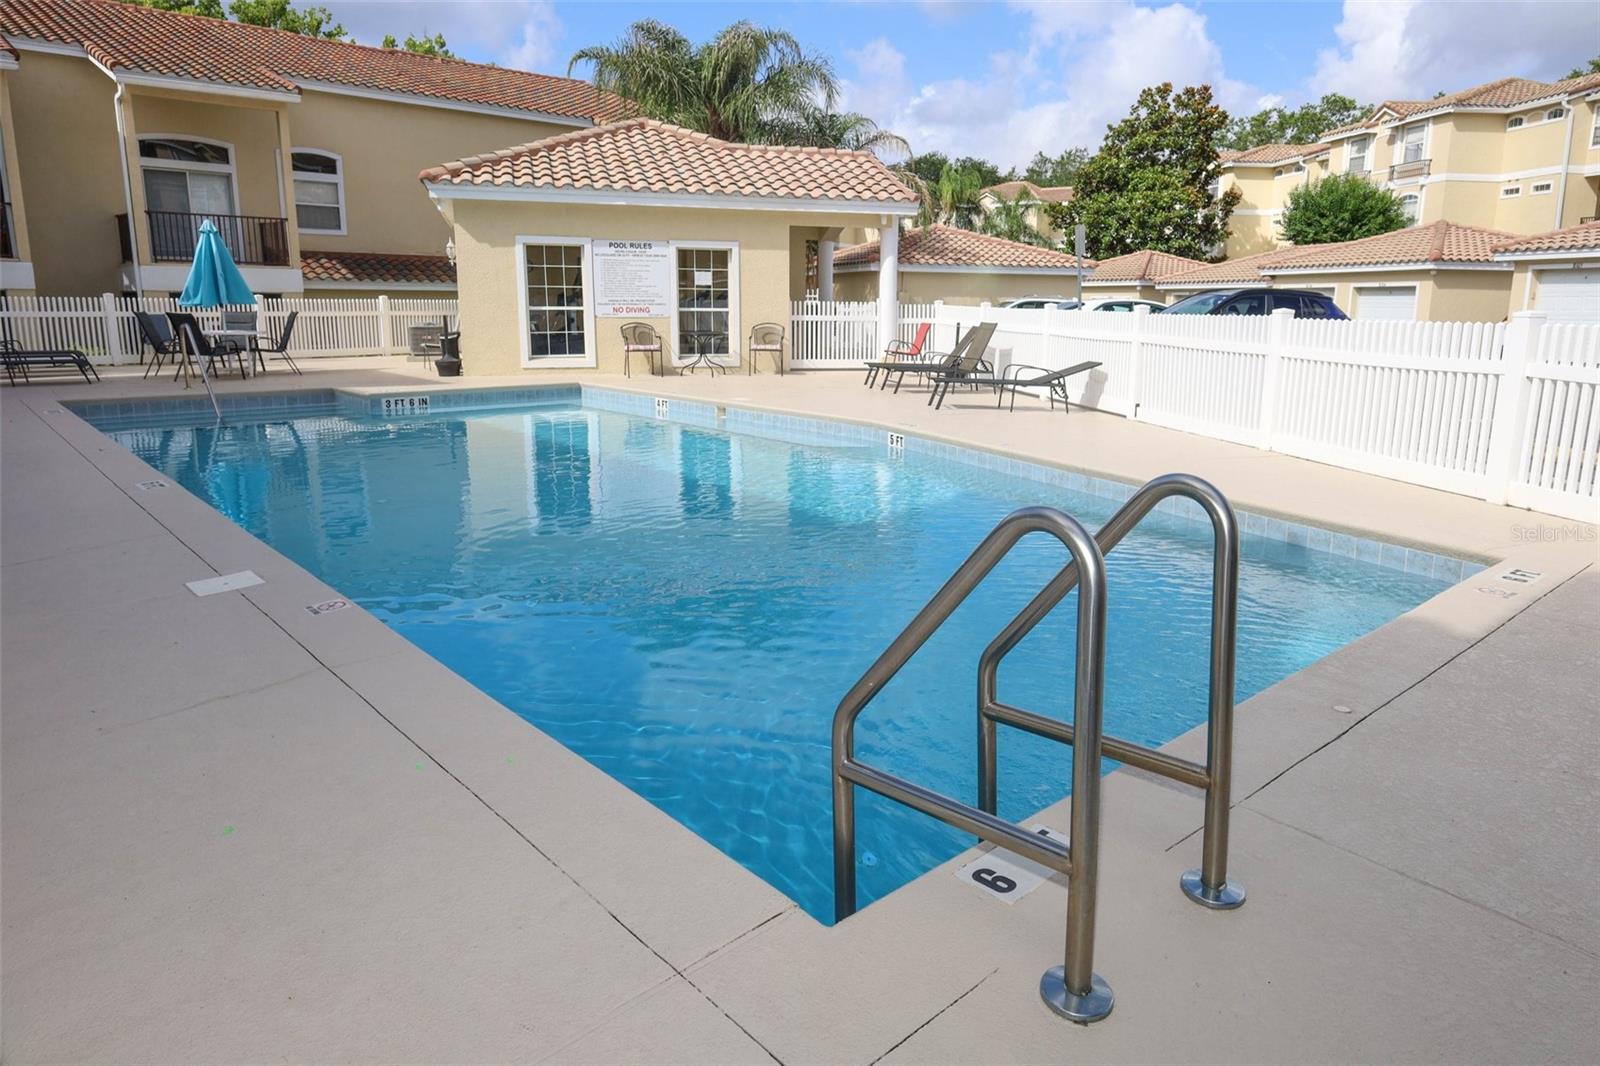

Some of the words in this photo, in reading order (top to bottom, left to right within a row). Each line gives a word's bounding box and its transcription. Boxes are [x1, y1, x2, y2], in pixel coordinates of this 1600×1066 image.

[385, 399, 391, 408] 3
[409, 398, 415, 406] 6
[418, 397, 428, 406] IN
[890, 434, 894, 445] 5
[896, 435, 903, 448] FT
[971, 868, 1017, 893] 6
